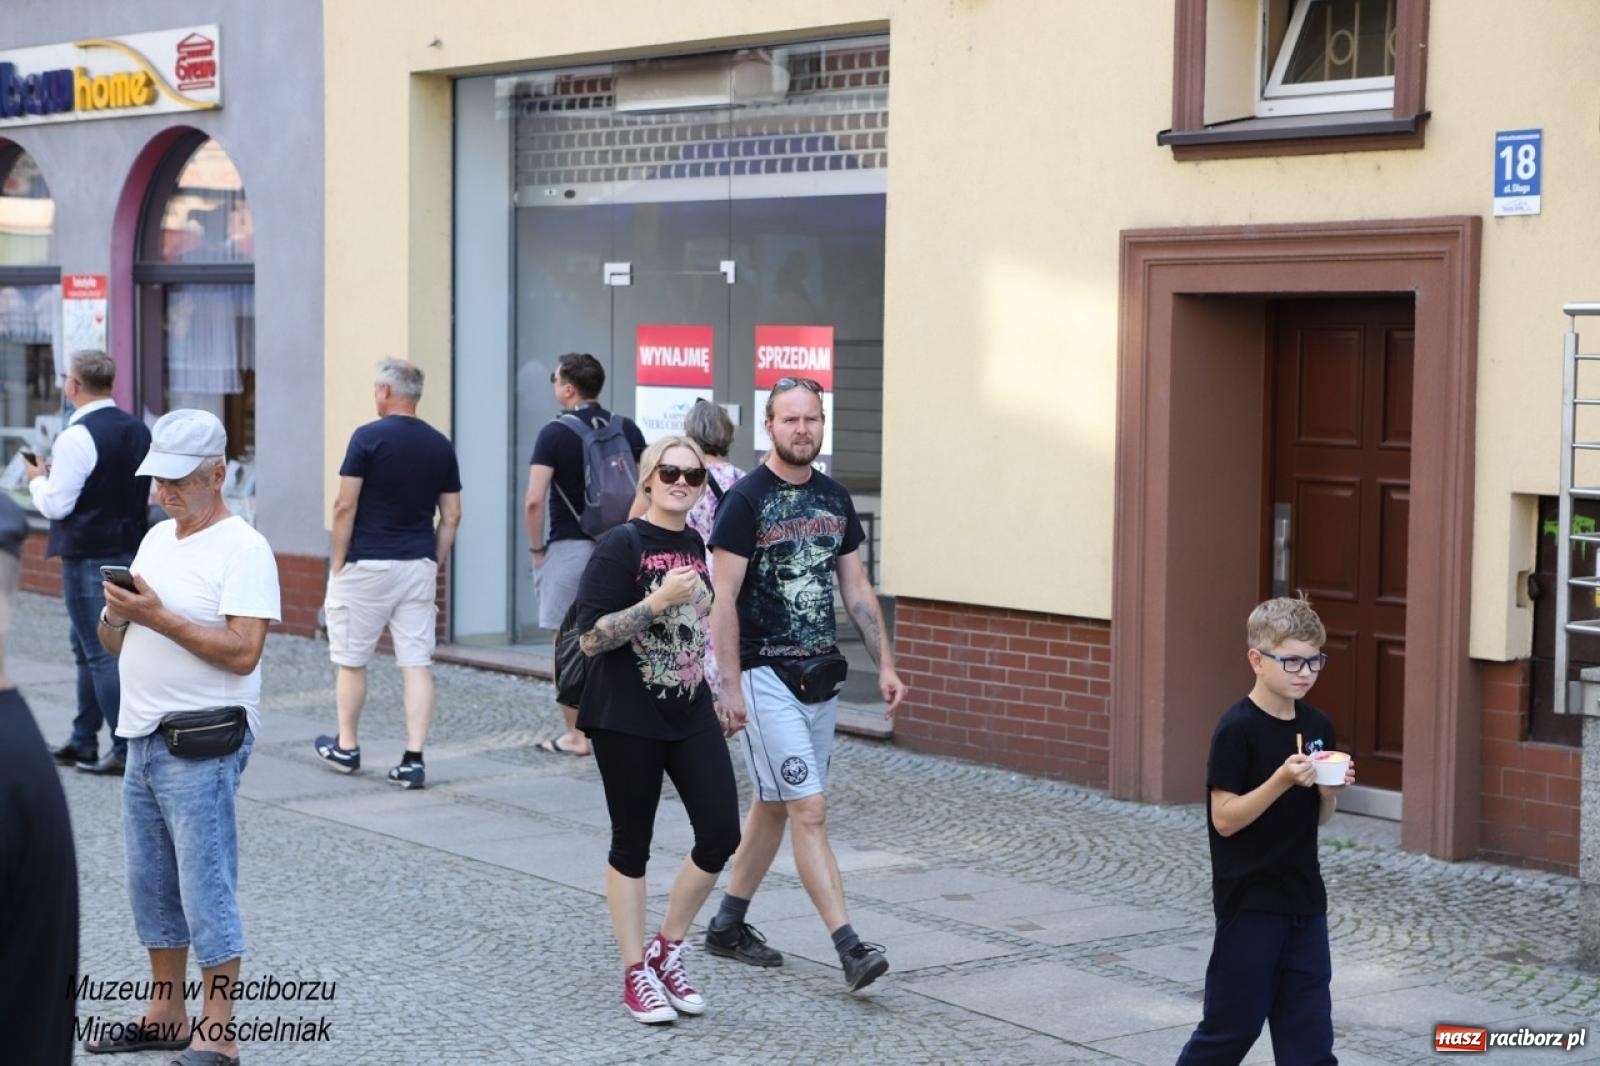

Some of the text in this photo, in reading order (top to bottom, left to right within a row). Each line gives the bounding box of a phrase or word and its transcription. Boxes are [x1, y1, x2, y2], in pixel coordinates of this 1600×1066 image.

[74, 67, 151, 111] home
[1500, 144, 1536, 181] 18
[640, 346, 710, 373] WYNAJMĘ
[757, 345, 831, 371] SPRZEDAM
